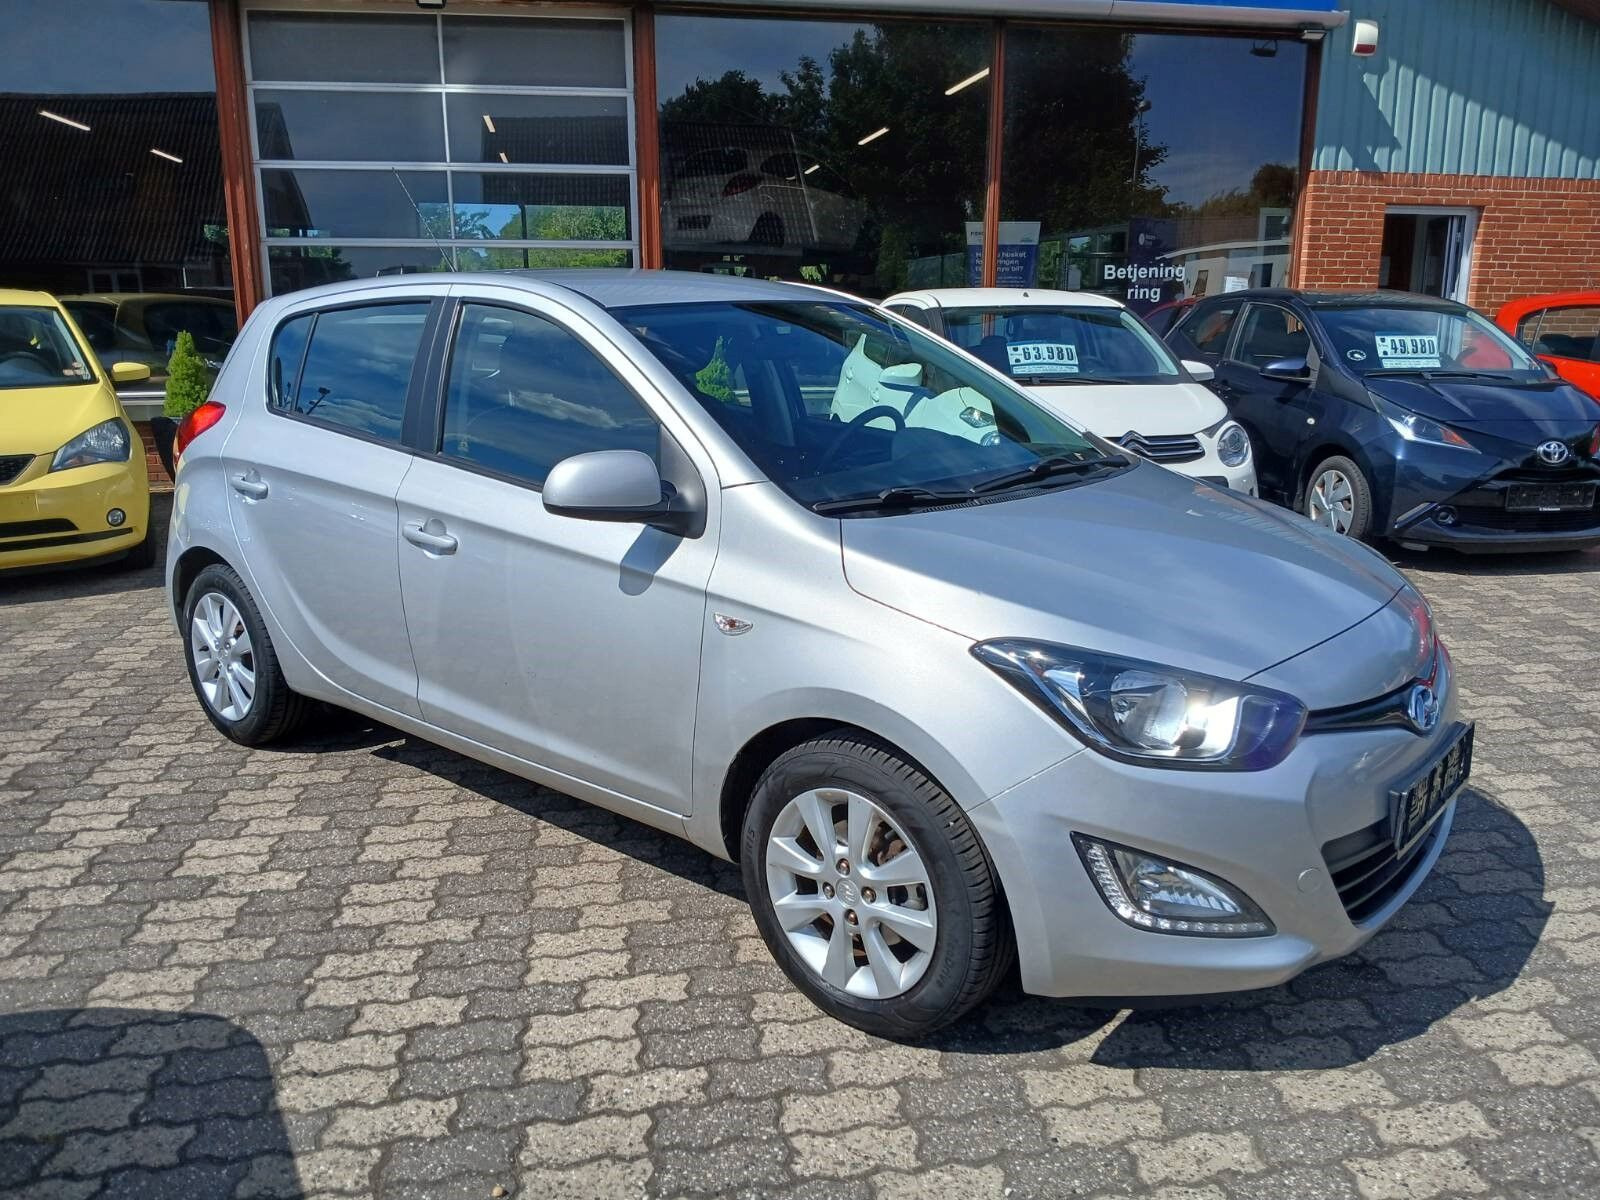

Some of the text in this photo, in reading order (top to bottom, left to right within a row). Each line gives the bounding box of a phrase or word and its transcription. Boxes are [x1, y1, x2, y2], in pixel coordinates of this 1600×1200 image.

[1103, 263, 1186, 283] Betjening
[1127, 284, 1161, 303] ring
[1022, 346, 1075, 361] 63.980
[1390, 338, 1436, 355] 49.980
